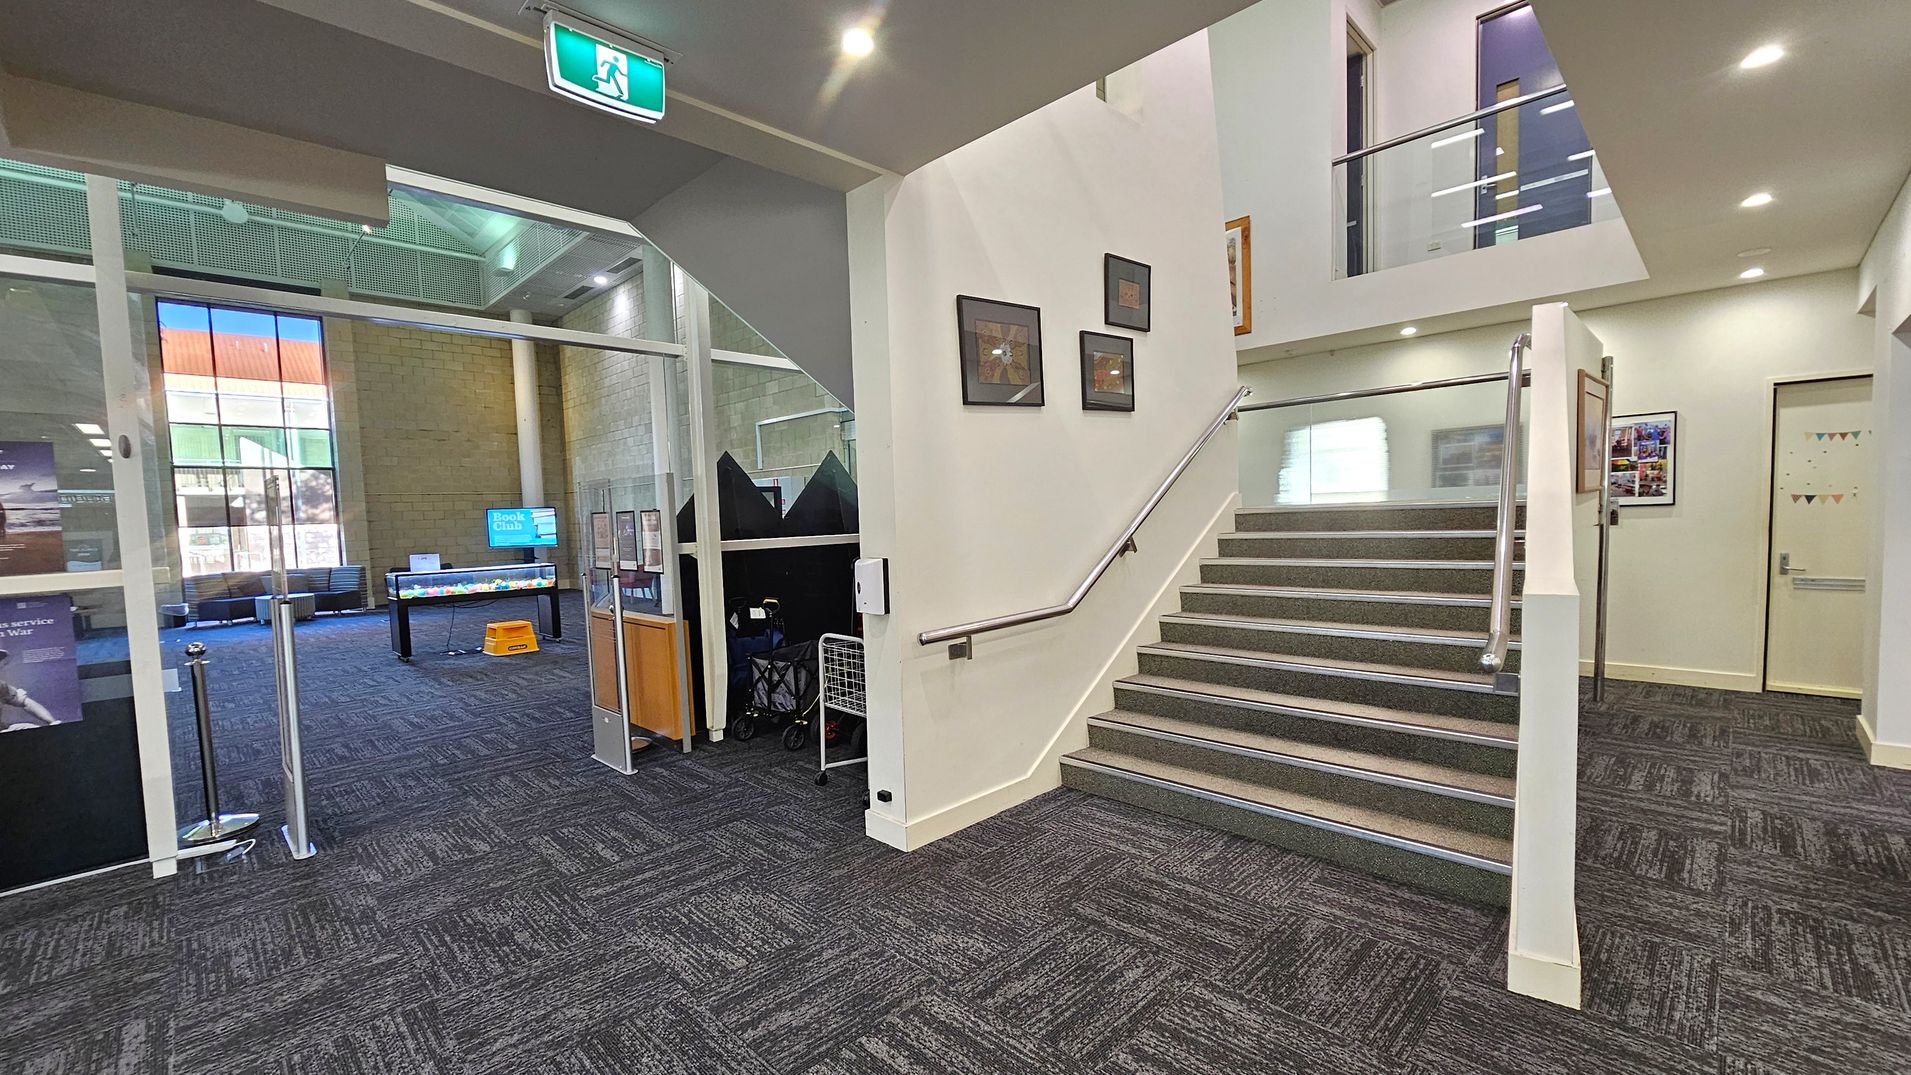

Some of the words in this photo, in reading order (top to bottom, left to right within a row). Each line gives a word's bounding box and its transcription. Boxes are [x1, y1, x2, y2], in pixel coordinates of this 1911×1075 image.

[493, 512, 525, 521] Book
[493, 521, 522, 530] Club
[10, 618, 55, 628] service
